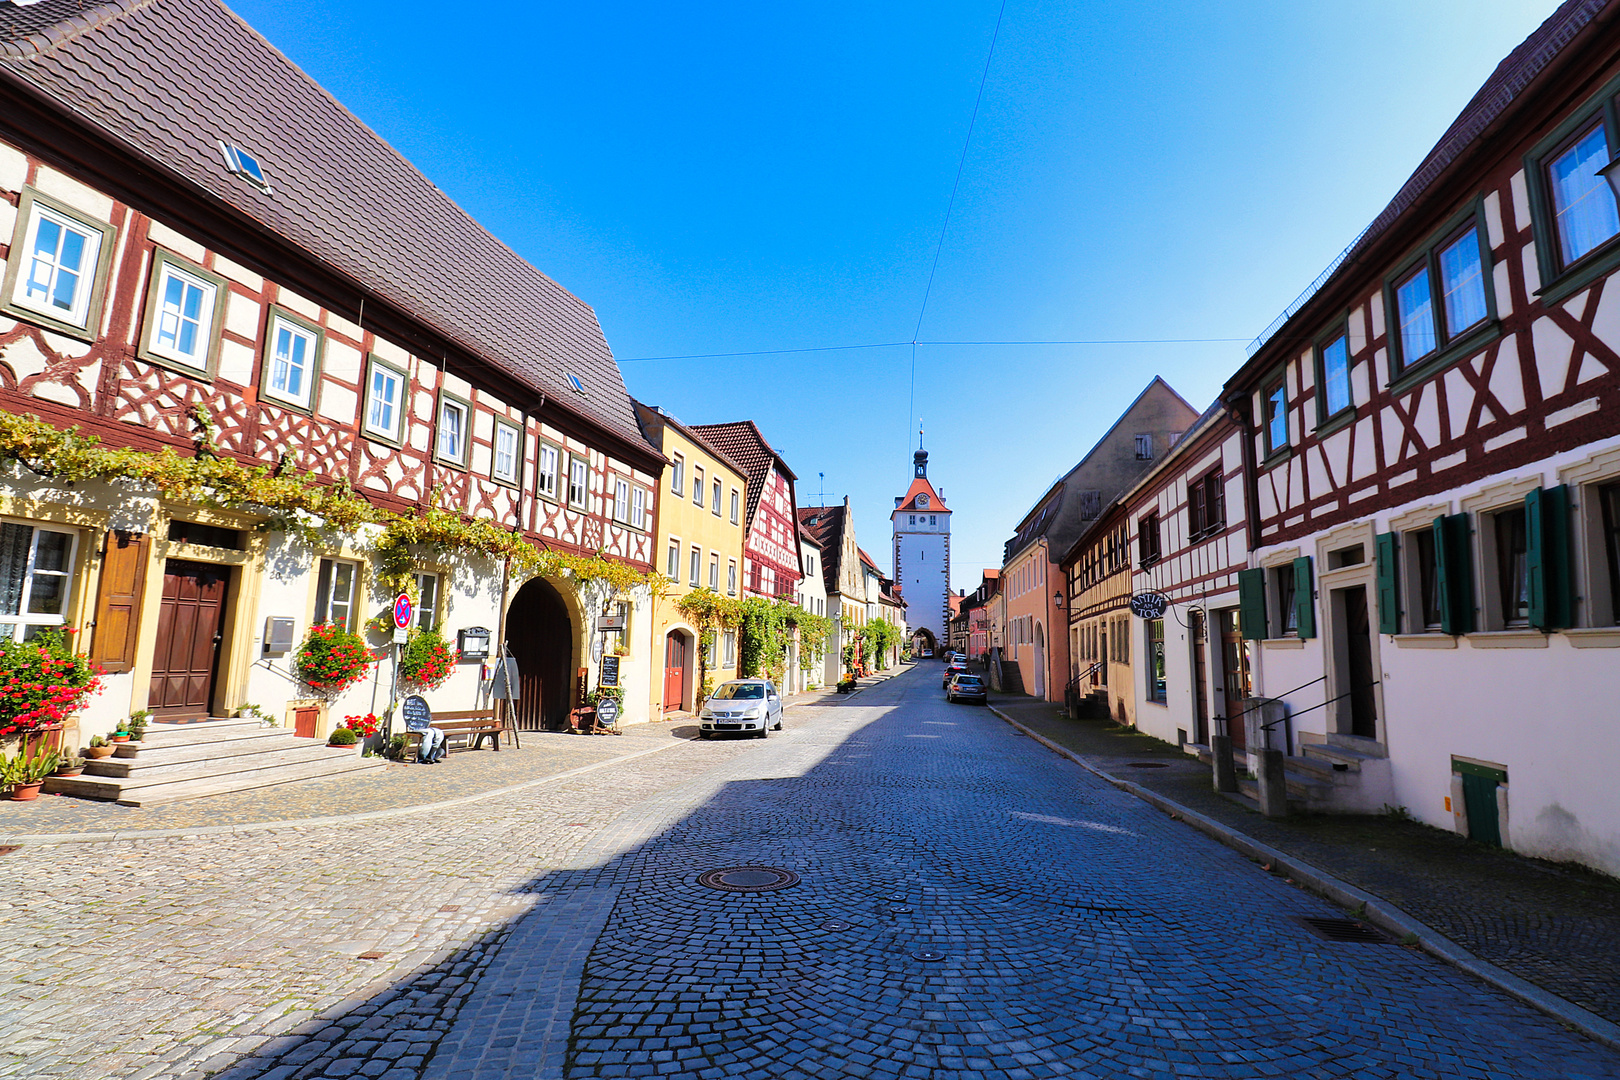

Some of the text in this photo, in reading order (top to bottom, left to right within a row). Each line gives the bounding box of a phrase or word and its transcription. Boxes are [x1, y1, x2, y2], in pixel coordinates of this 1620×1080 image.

[269, 569, 281, 580] 20
[1131, 594, 1163, 608] ANTIK
[1138, 608, 1160, 618] TOR
